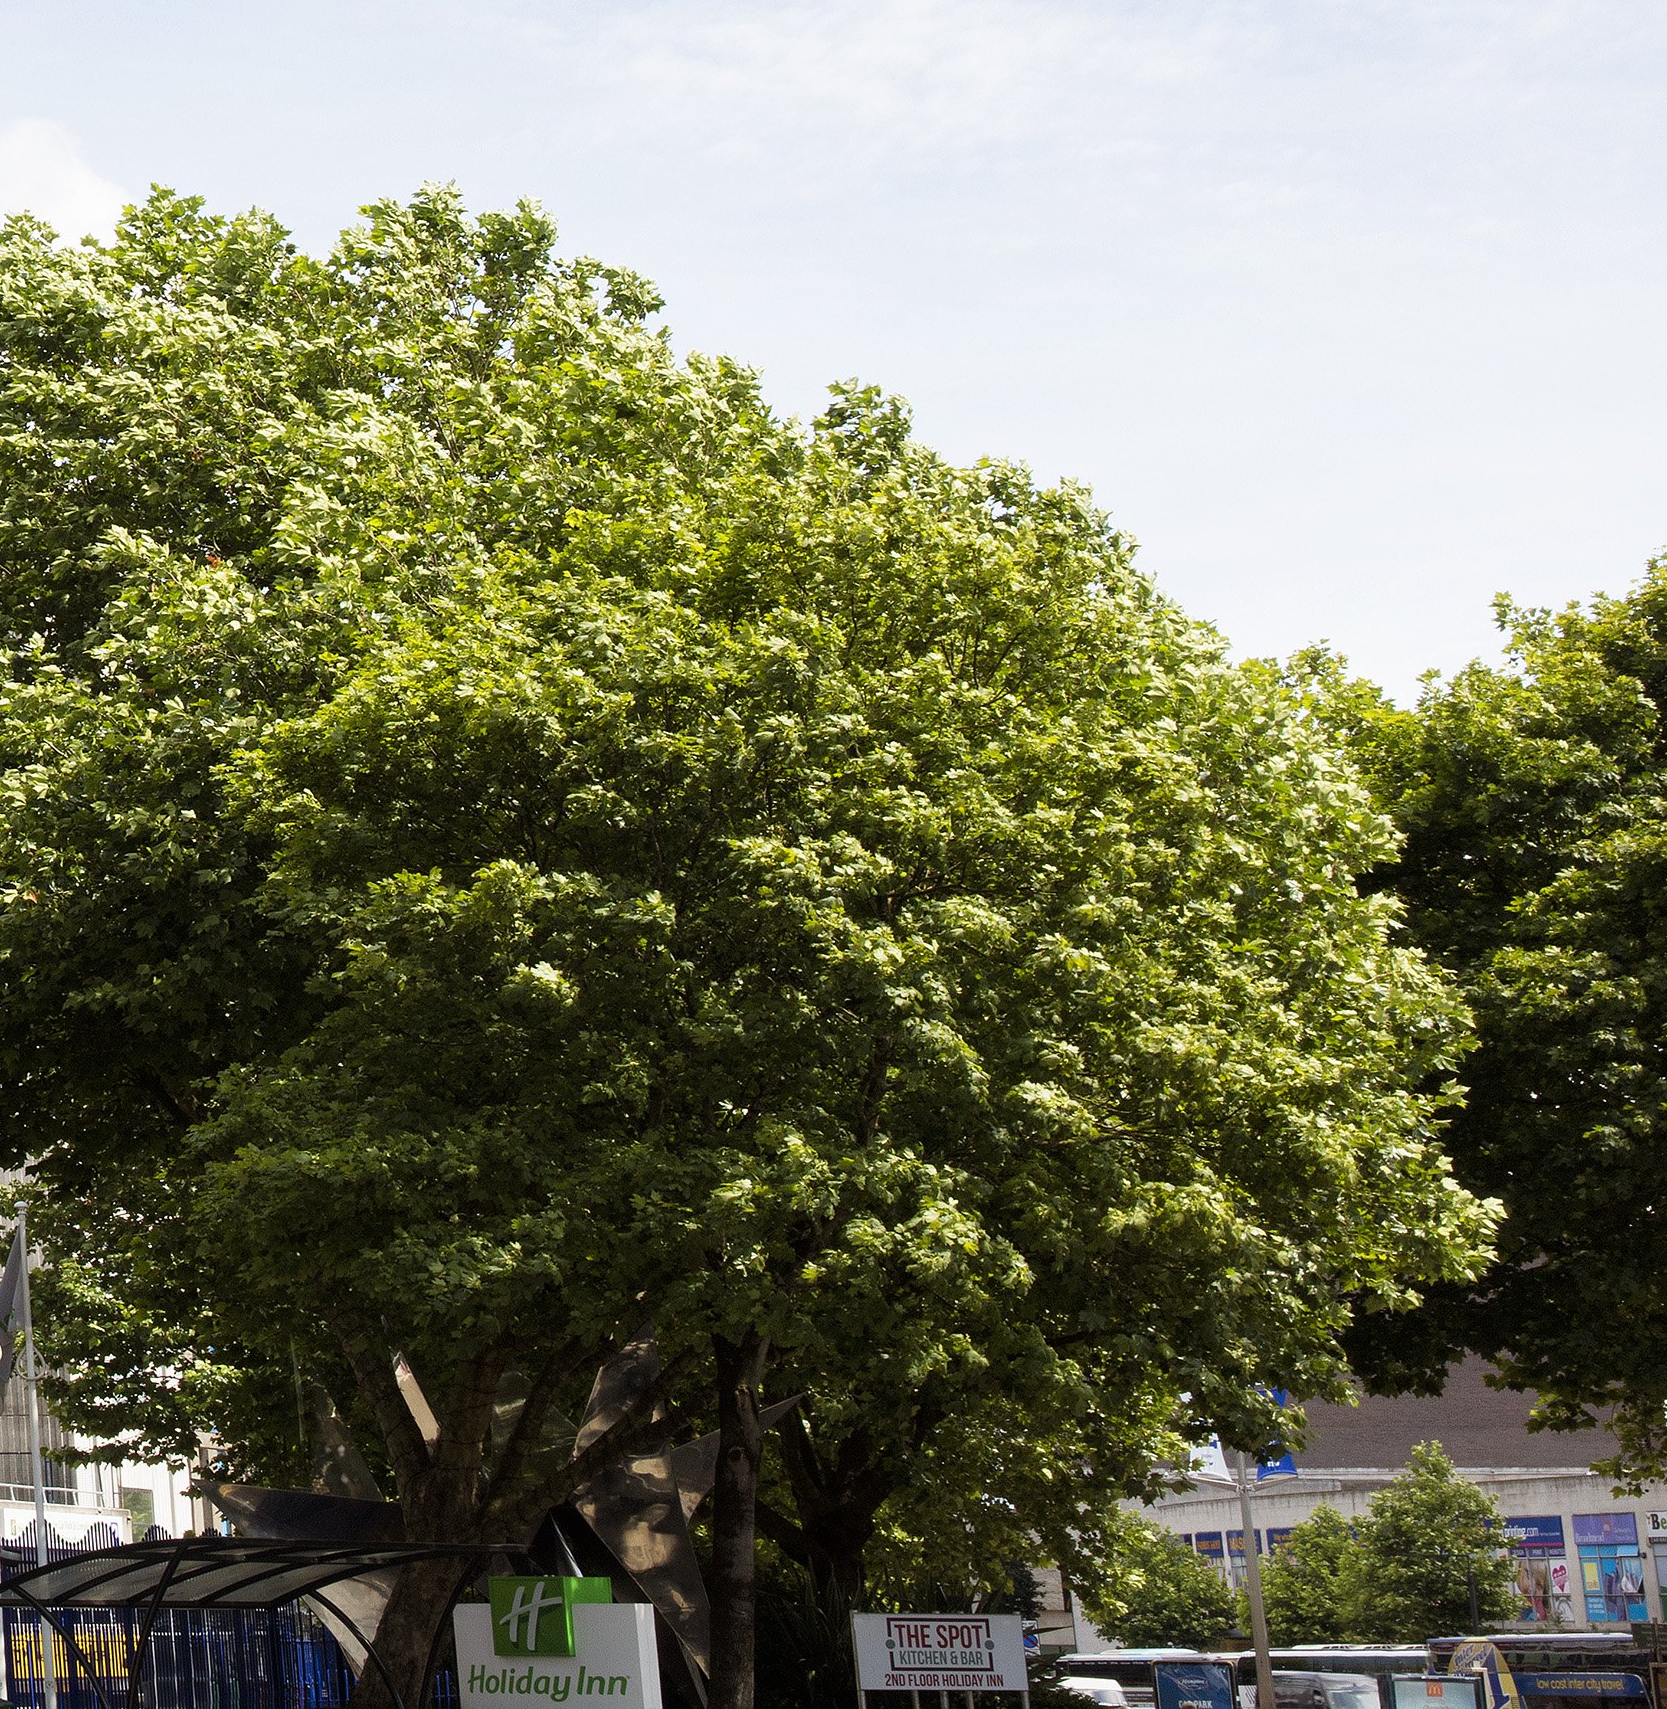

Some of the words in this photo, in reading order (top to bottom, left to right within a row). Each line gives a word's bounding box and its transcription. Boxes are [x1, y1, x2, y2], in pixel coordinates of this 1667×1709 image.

[894, 1624, 932, 1649] THE
[936, 1624, 983, 1649] SPOT
[899, 1650, 948, 1665] KITCHEN
[950, 1651, 958, 1665] &
[961, 1651, 984, 1665] BAR
[467, 1664, 571, 1702] Holiday
[577, 1665, 628, 1696] Inn
[884, 1673, 906, 1687] 2ND
[908, 1673, 939, 1687] FLOOR
[942, 1674, 983, 1687] HOLIDAY
[986, 1674, 1004, 1687] INN
[1536, 1678, 1549, 1689] low
[1550, 1678, 1566, 1689] cost
[1568, 1678, 1585, 1689] inter
[1586, 1678, 1601, 1693] city
[1602, 1678, 1625, 1690] travel
